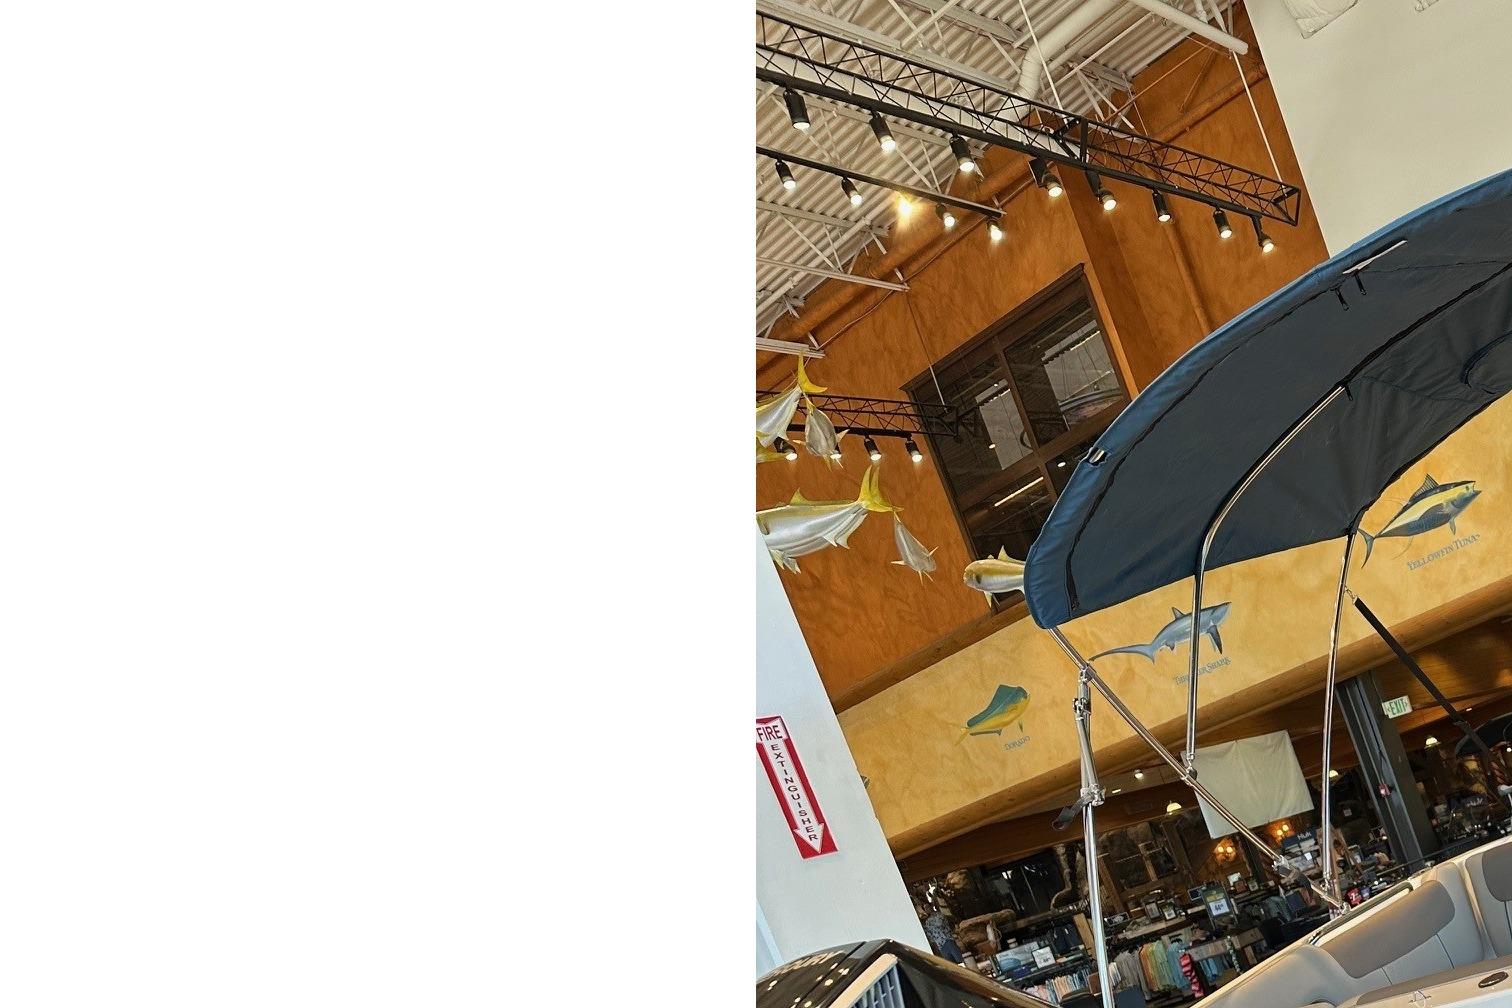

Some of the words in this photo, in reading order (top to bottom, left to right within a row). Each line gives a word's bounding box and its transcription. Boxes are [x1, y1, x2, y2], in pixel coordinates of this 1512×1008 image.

[1407, 543, 1454, 571] YELLOWFIN
[1389, 697, 1406, 716] EXIT
[756, 725, 783, 742] FIRE
[770, 743, 819, 841] EXTINGUISHER
